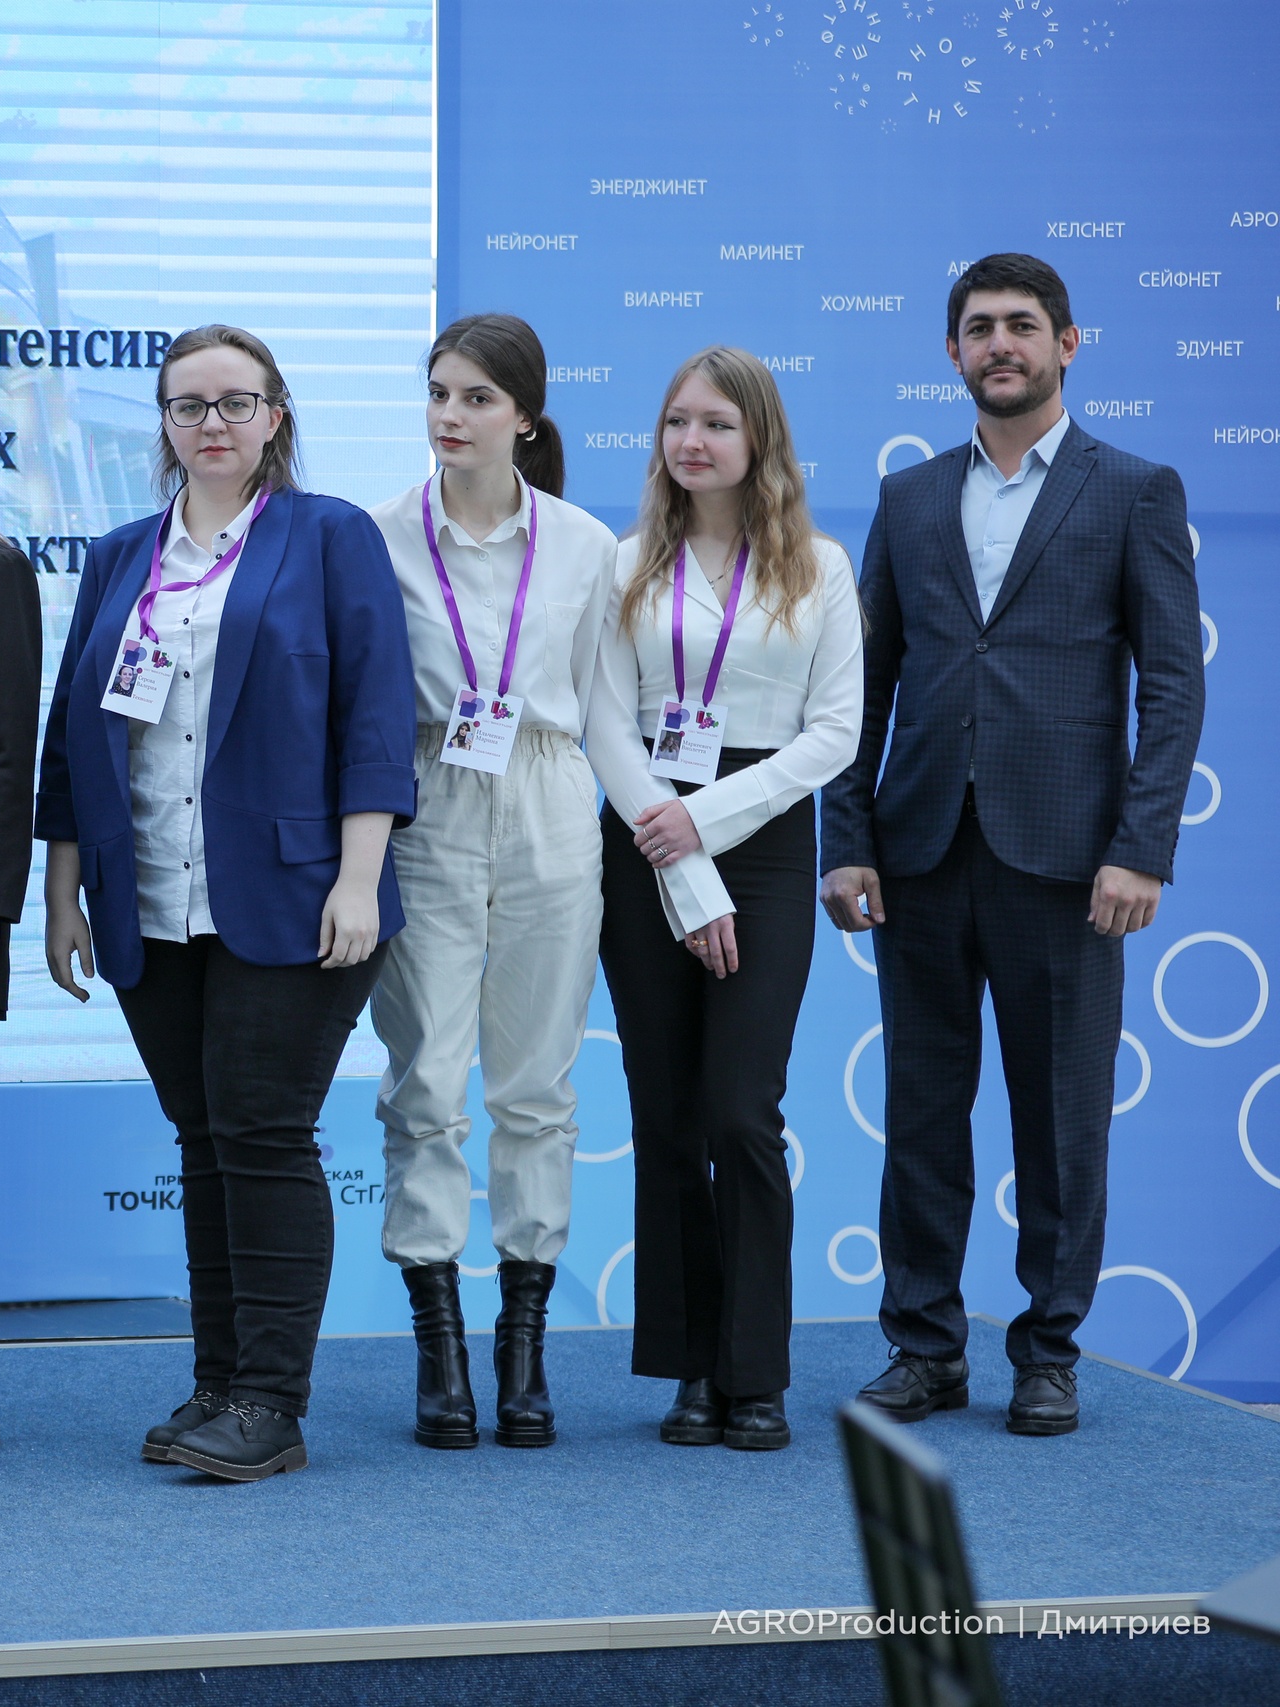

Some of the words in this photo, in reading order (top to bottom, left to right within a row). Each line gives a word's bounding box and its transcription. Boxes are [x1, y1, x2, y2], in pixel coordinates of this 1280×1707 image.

[590, 178, 708, 198] ЭНЕРДЖИНЕТ
[1229, 211, 1280, 228] АЭРО
[1046, 221, 1126, 238] ХЕЛСНЕТ
[486, 231, 579, 250] НЕЙРОНЕТ
[719, 244, 805, 261] МАРИНЕТ
[1138, 268, 1222, 288] СЕЙФНЕТ
[624, 291, 704, 308] ВИАРНЕТ
[821, 295, 905, 312] ХОУМНЕТ
[1175, 340, 1244, 359] ЭДУНЕТ
[896, 384, 973, 404] ЭНЕРДЖ
[1084, 399, 1154, 420] ФУДНЕТ
[585, 432, 655, 449] ХЕЛСНЕ
